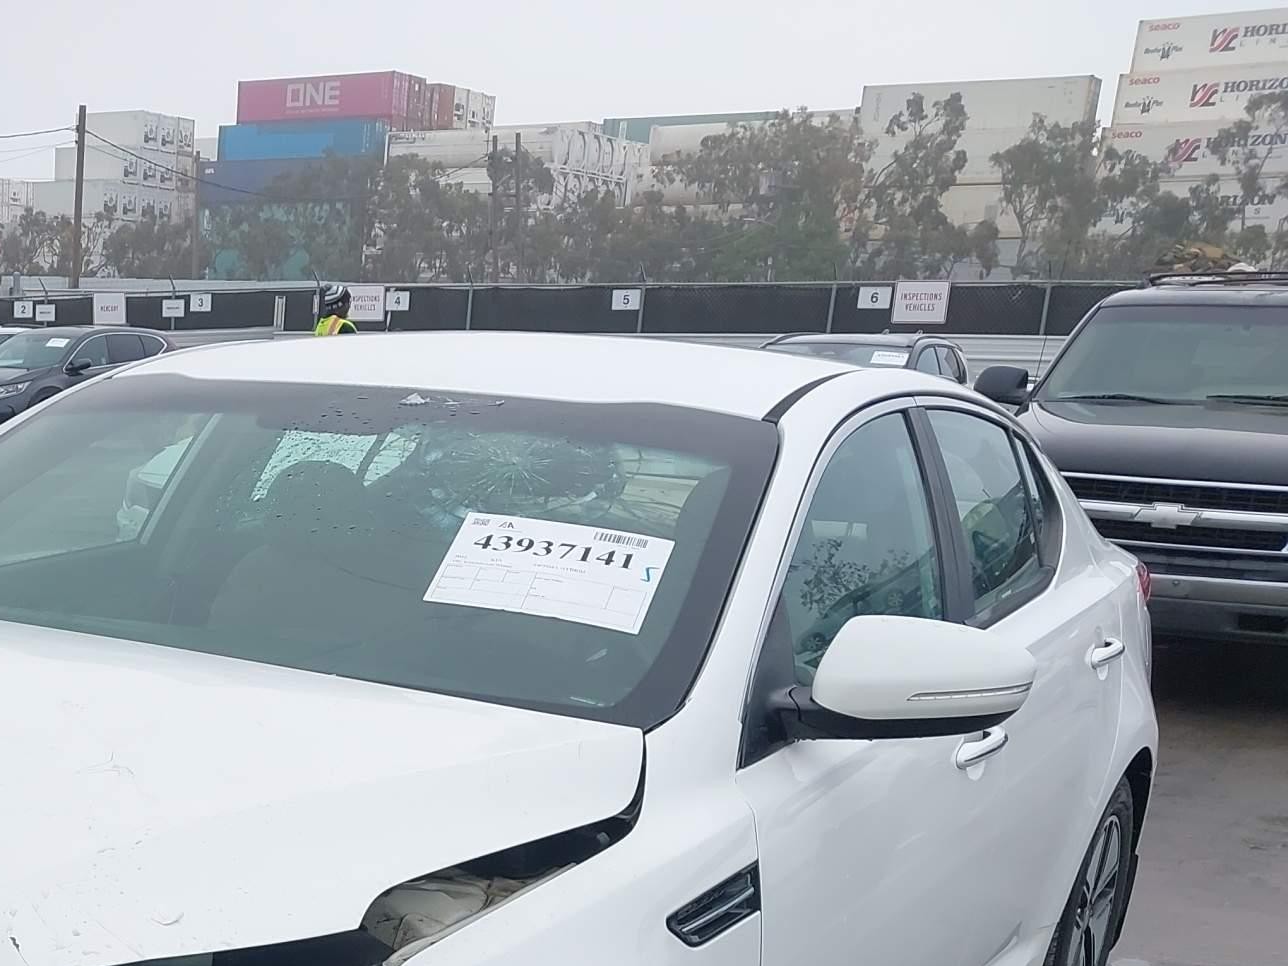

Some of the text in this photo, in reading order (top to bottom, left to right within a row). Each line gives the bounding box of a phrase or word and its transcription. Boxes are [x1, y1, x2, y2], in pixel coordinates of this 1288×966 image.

[1149, 22, 1180, 31] seaco
[1129, 77, 1160, 86] seaco
[286, 81, 341, 107] ONE
[1112, 130, 1142, 139] seaco
[352, 295, 380, 303] NSPECTIONS
[394, 296, 401, 306] 4
[623, 294, 630, 305] 5
[870, 292, 879, 303] 6
[901, 292, 942, 301] INSPECTIONS
[198, 298, 204, 307] 3
[20, 305, 26, 314] 2
[905, 303, 935, 312] VEHICLES
[474, 534, 634, 570] 43937141
